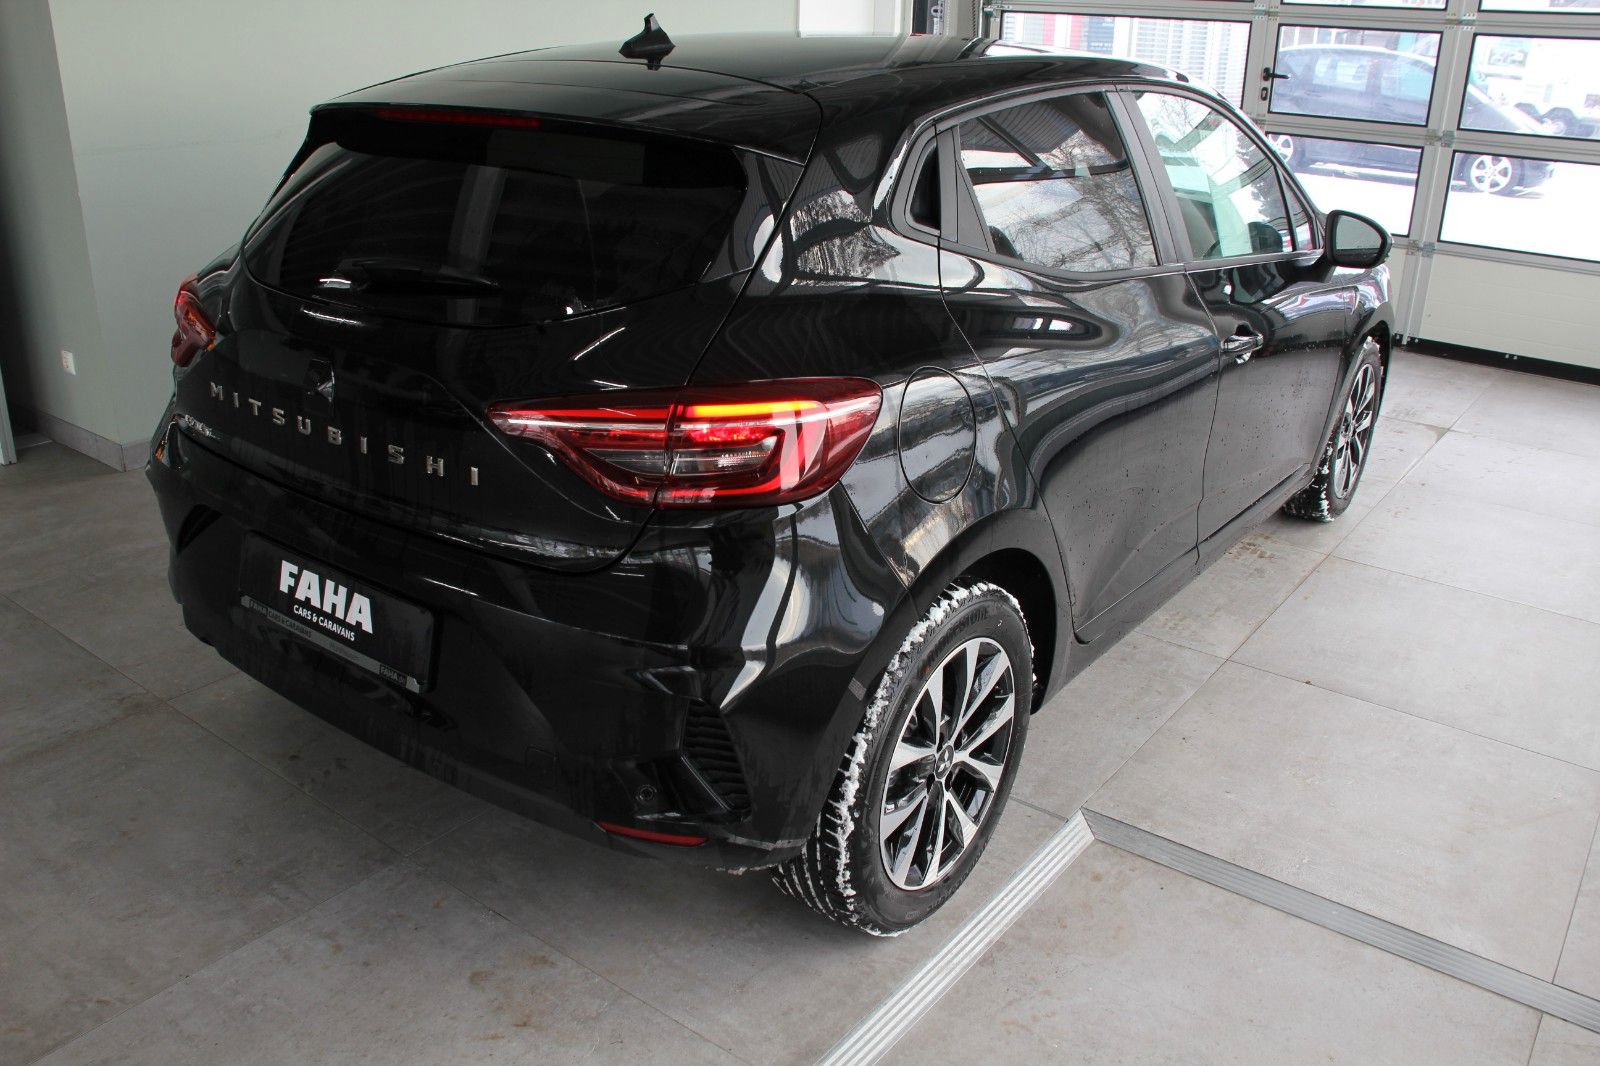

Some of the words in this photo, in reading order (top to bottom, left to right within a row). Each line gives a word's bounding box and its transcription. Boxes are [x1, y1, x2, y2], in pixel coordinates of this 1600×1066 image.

[209, 381, 479, 486] MITSUBISHI
[279, 559, 374, 634] FAHA
[294, 604, 312, 620] CARS
[312, 613, 318, 623] &
[318, 617, 355, 641] CARAVANS
